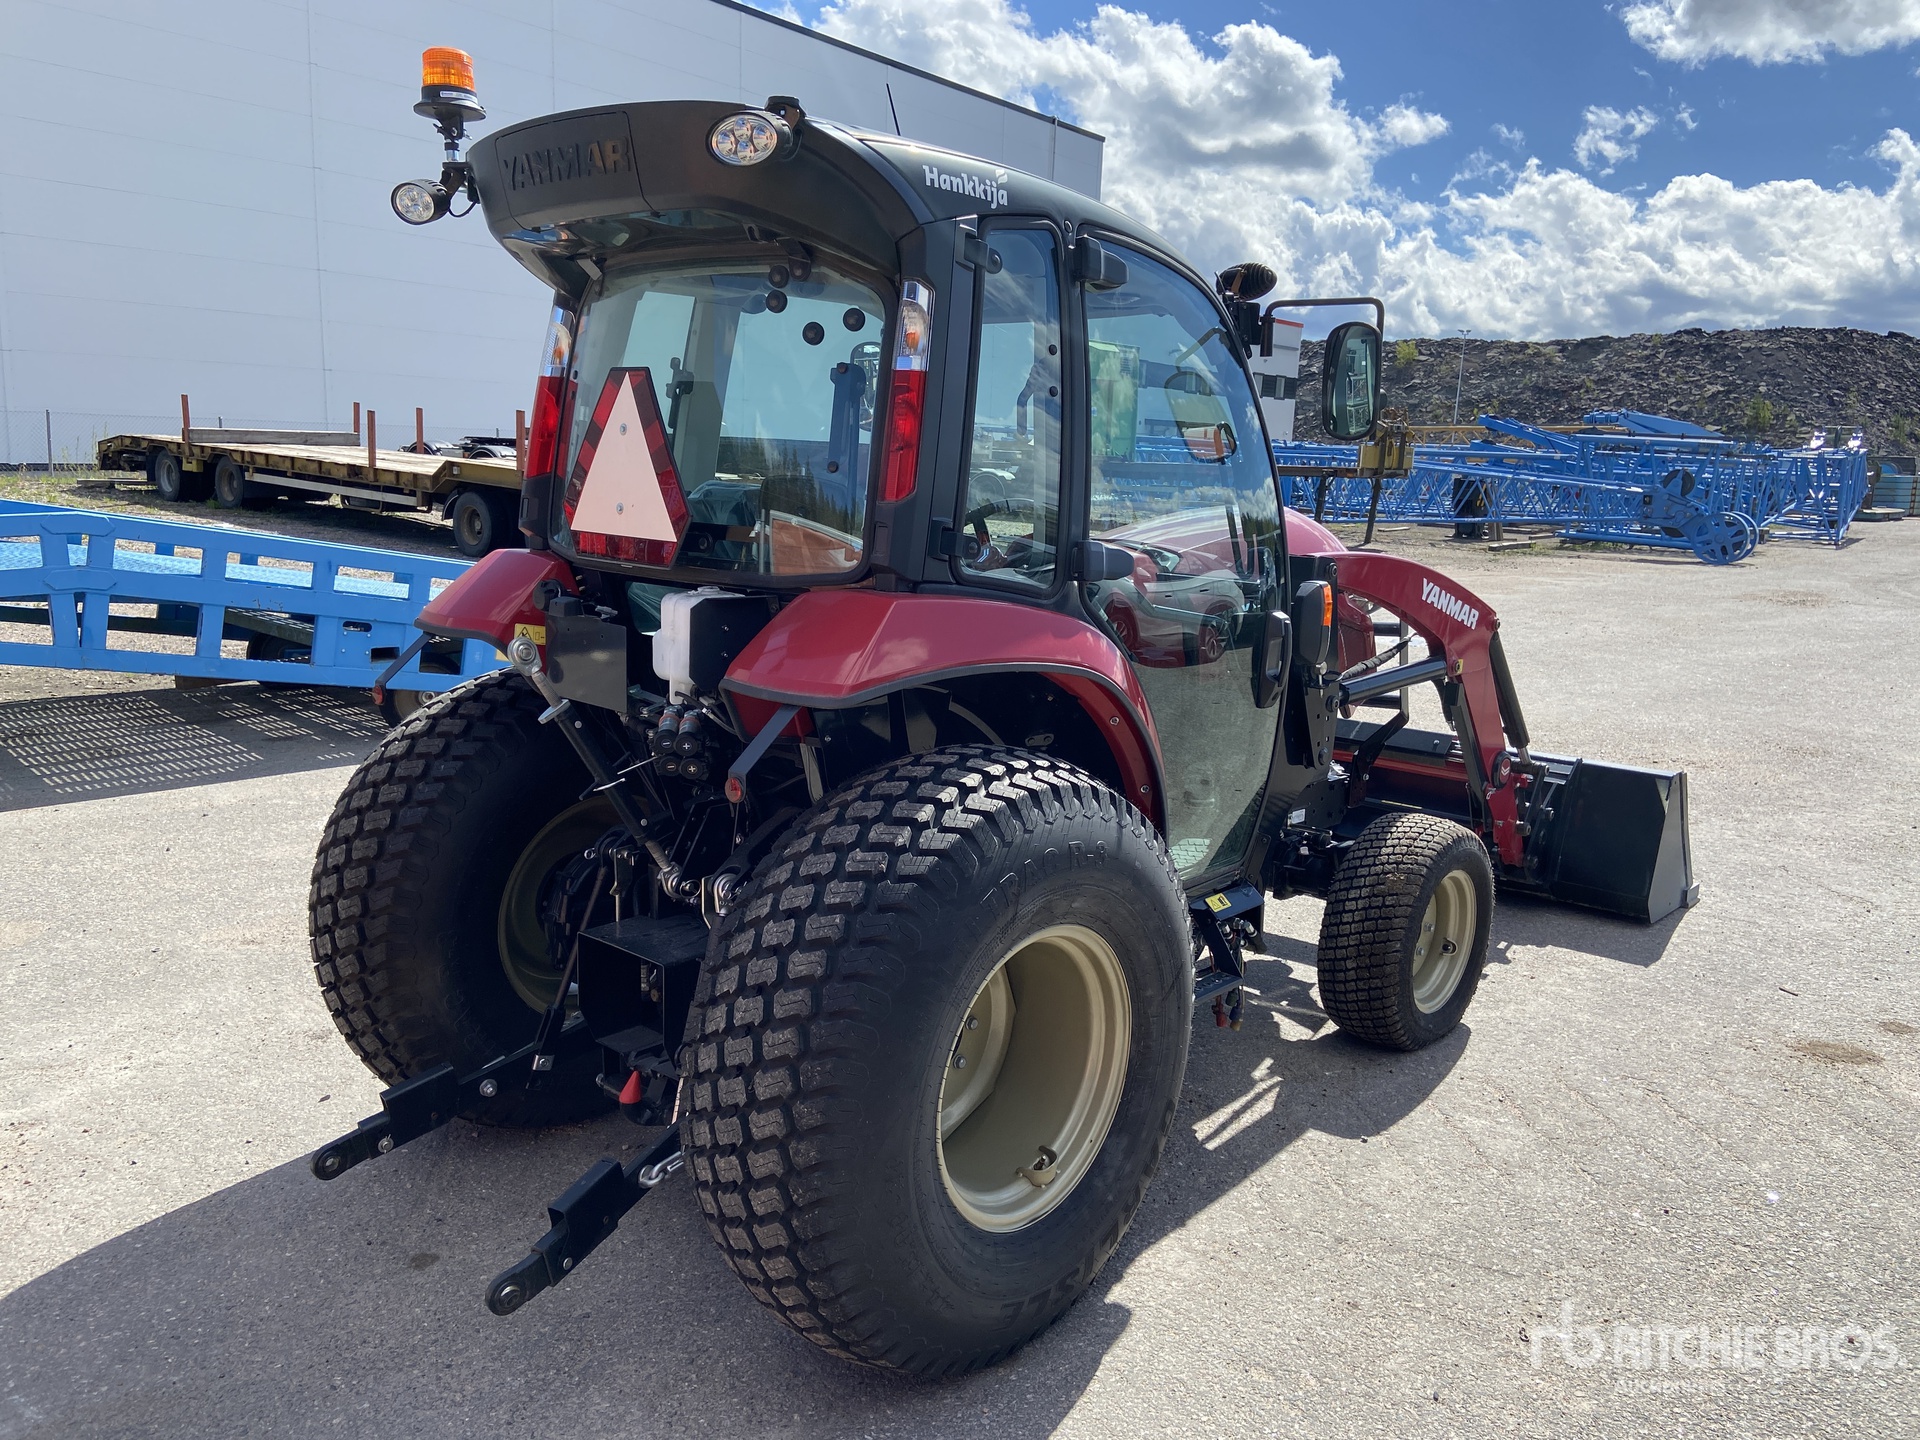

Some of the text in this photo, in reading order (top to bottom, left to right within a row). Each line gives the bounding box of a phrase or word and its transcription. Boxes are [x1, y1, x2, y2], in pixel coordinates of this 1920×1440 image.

[503, 137, 632, 191] YANMAR
[922, 165, 1008, 209] Hankkija
[1421, 577, 1480, 630] YANMAR
